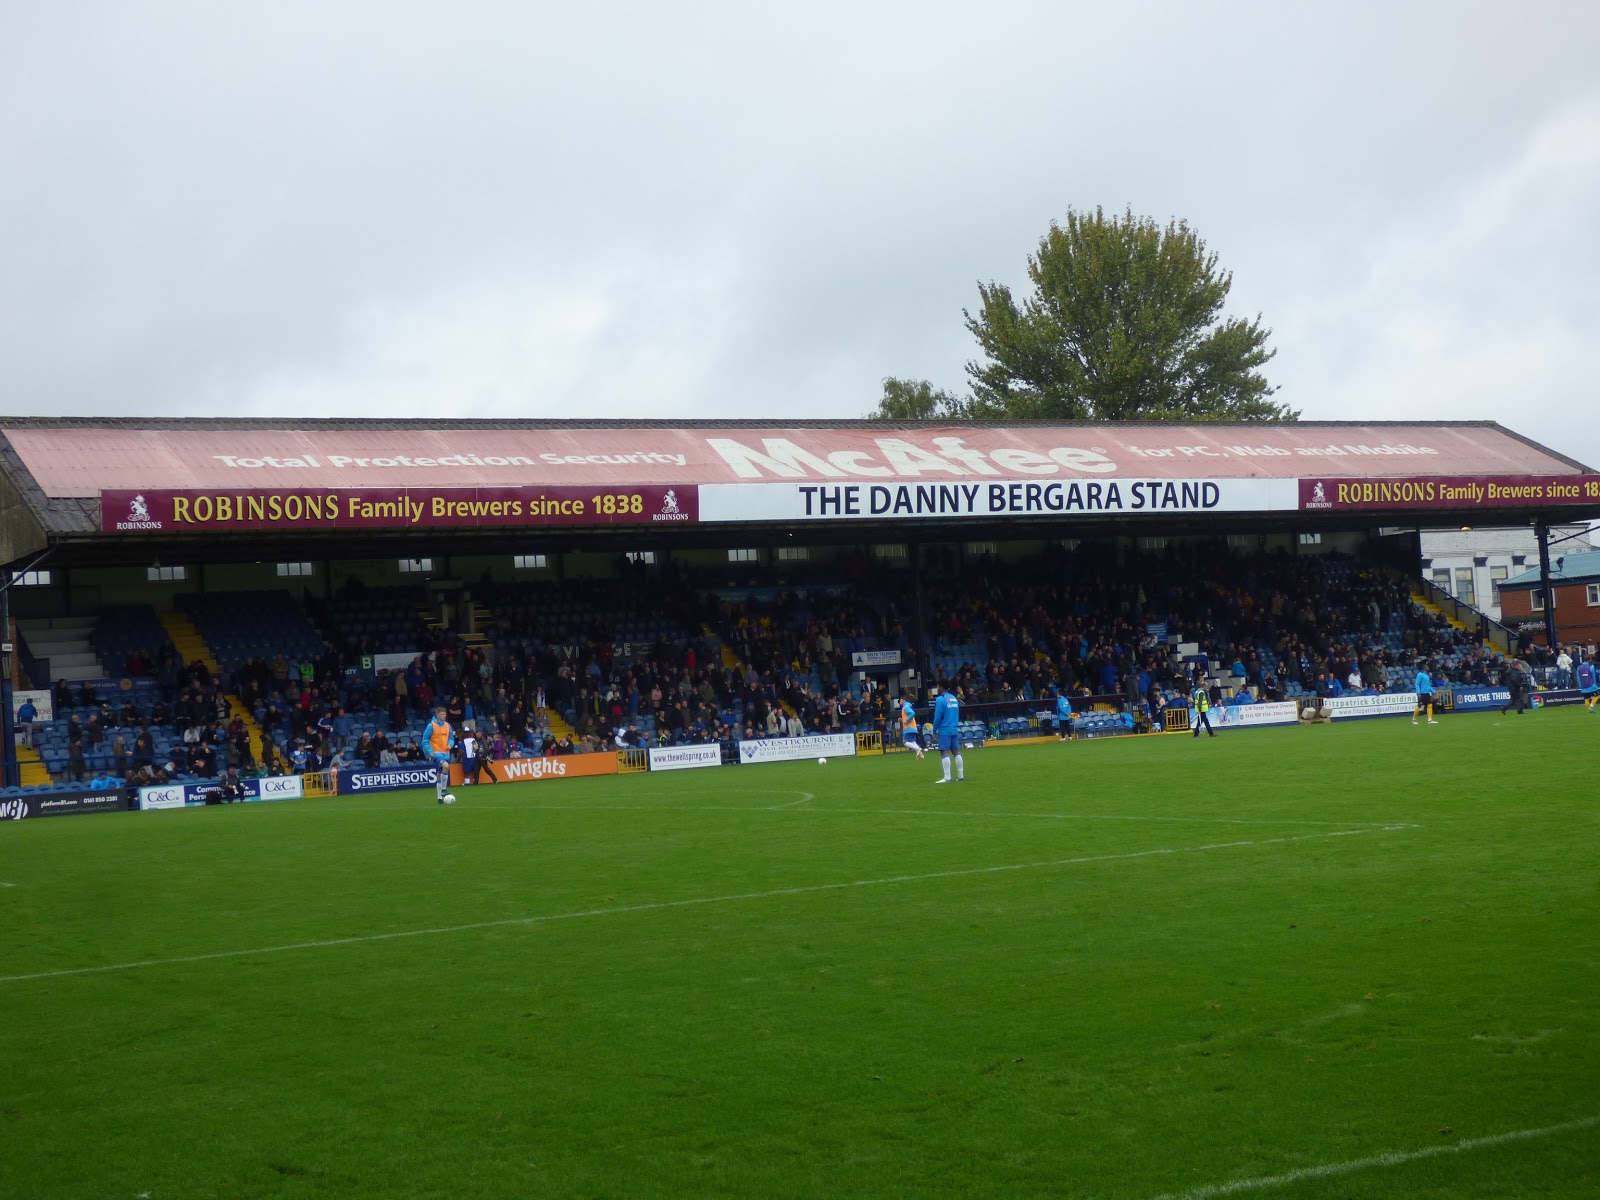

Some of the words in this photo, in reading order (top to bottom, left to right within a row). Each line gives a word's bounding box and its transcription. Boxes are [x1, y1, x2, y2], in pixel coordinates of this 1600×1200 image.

[1128, 445, 1171, 457] for
[1175, 446, 1229, 457] PC,
[1222, 444, 1292, 456] Web
[1294, 444, 1347, 456] and
[1342, 443, 1440, 455] Mobile
[213, 455, 320, 469] Total
[327, 453, 531, 468] Protection
[540, 451, 687, 470] Security
[798, 485, 860, 516] THE
[869, 484, 980, 515] DANNY
[988, 482, 1124, 513] BERGARA
[1131, 481, 1220, 509] STAND
[1337, 482, 1435, 504] ROBINSONS
[1440, 482, 1484, 503] Family
[1488, 483, 1543, 500] Brewers
[1546, 481, 1580, 498] since
[1584, 480, 1600, 497] 18
[173, 495, 339, 524] ROBINSONS
[349, 494, 424, 523] Family
[431, 495, 523, 517] Brewers
[529, 495, 585, 517] since
[591, 494, 644, 515] 1838
[652, 512, 689, 521] ROBINSONS
[116, 520, 162, 530] ROBINSONS
[362, 657, 372, 670] B
[1324, 698, 1368, 708] Fitzpatrick
[1371, 695, 1417, 705] Scaffolding
[1464, 695, 1477, 703] FOR
[1478, 693, 1491, 702] THE
[1492, 692, 1511, 700] THIRS
[757, 736, 836, 748] WESTBOURNE
[654, 749, 717, 763] www.thewellspring.co.uk
[503, 757, 566, 779] Wrights
[352, 768, 438, 790] STEPHENSONS
[264, 780, 292, 792] C&C
[147, 790, 176, 803] C&C
